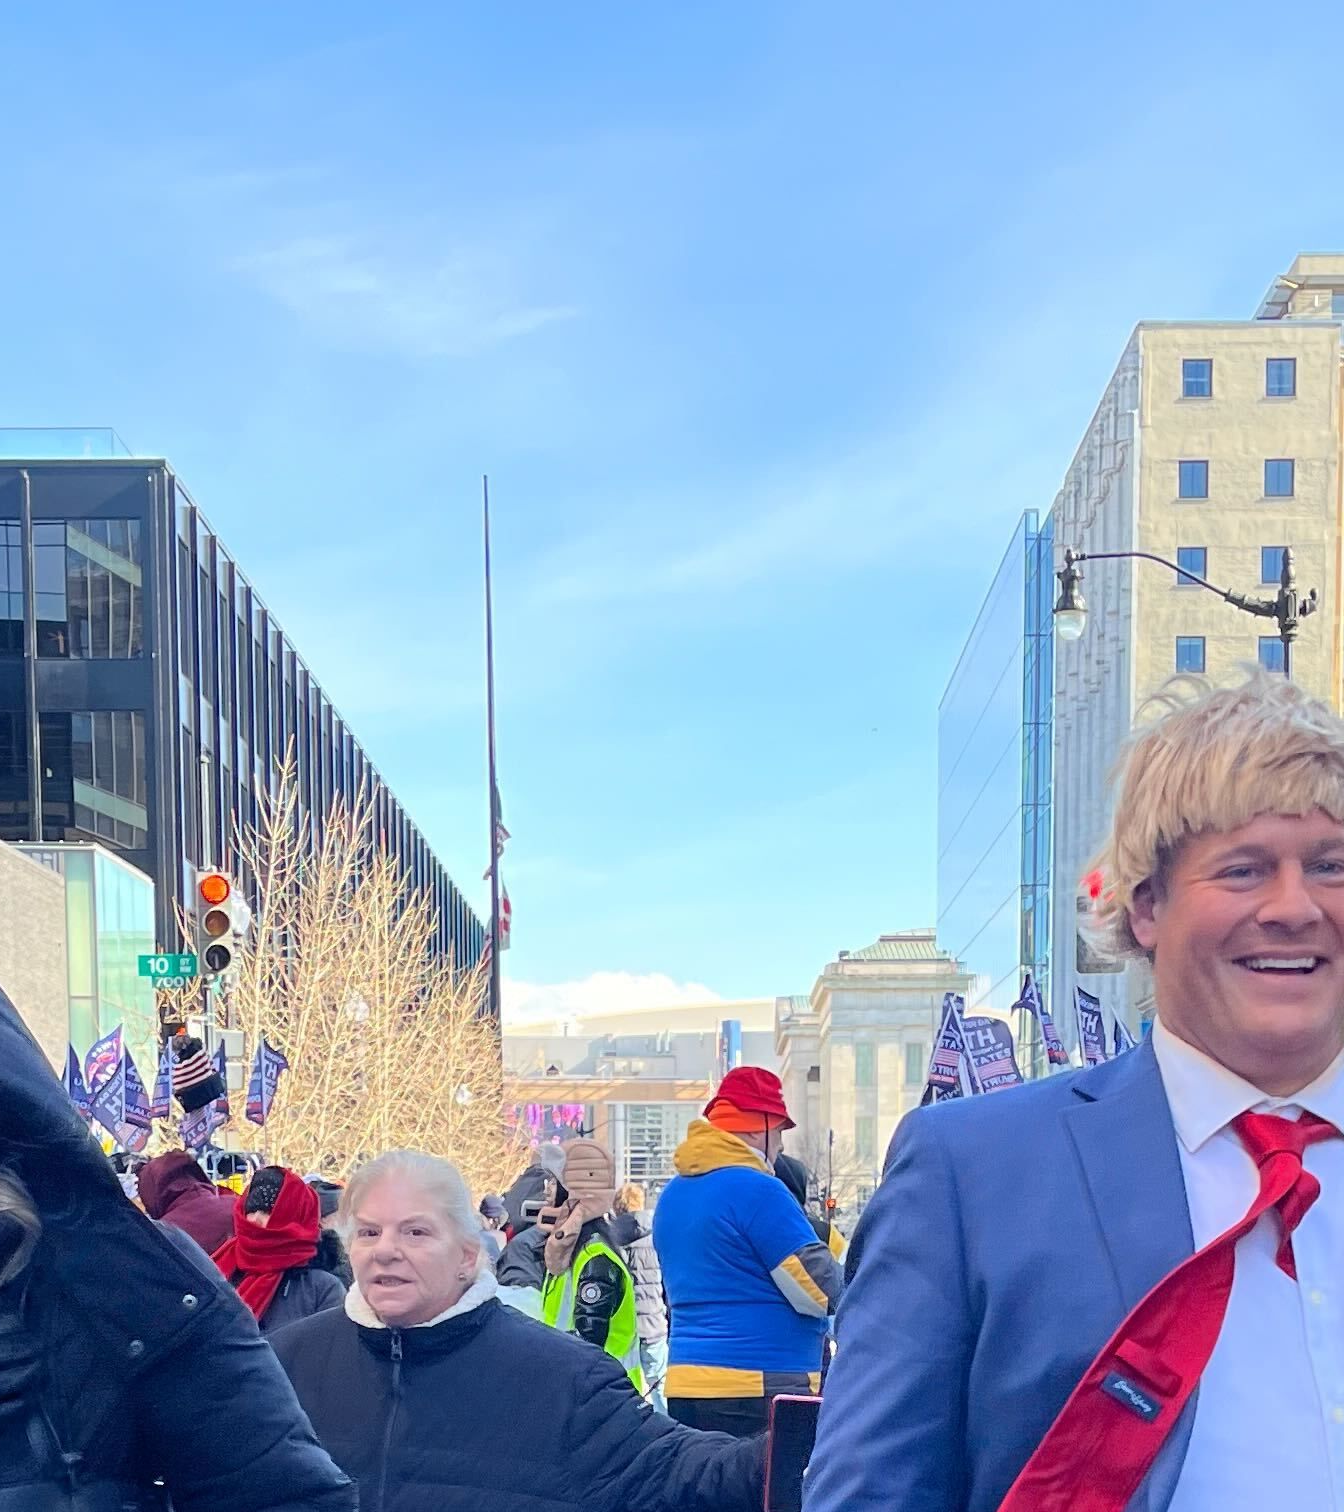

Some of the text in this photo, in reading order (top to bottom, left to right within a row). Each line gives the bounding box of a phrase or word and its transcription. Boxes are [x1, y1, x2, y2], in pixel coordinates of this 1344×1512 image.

[147, 957, 169, 974] 10
[155, 976, 184, 988] 700
[1081, 1011, 1099, 1033] TH
[965, 1028, 996, 1049] TH
[973, 1048, 1011, 1066] TATES
